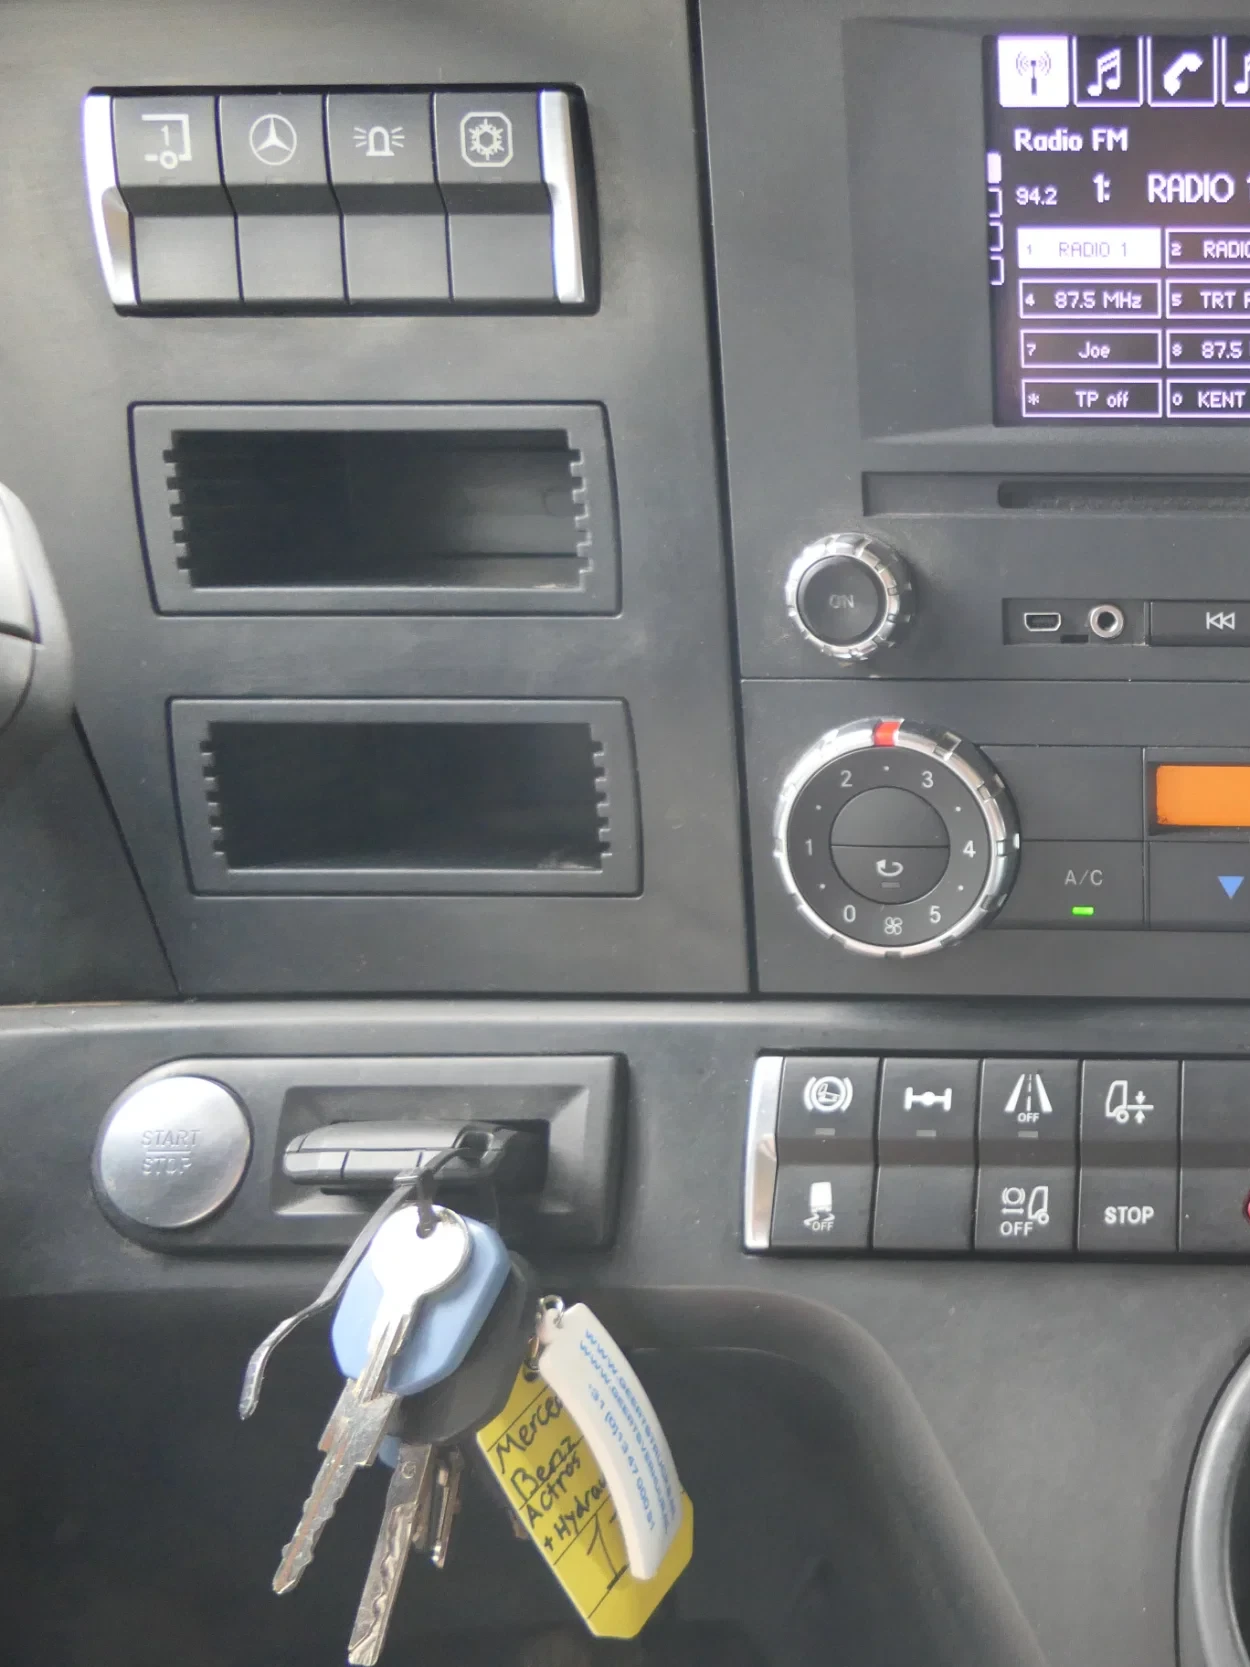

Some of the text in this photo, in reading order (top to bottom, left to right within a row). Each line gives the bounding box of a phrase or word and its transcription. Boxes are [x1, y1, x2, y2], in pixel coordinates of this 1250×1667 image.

[1014, 128, 1128, 152] Radio FM
[1015, 186, 1057, 205] 94.2
[1093, 173, 1111, 203] 1:
[1147, 173, 1235, 203] RADIO
[1058, 241, 1110, 257] RADIO
[1120, 241, 1128, 257] 1
[1171, 242, 1182, 256] 2
[1025, 291, 1142, 309] 4 87.5 MHz
[1171, 294, 1182, 307] 5
[1201, 292, 1236, 309] TRT
[1026, 342, 1110, 359] 7 Joe
[1172, 344, 1182, 357] 8
[1202, 342, 1242, 359] 87.5
[1076, 390, 1098, 408] TP
[1107, 390, 1129, 408] off
[1197, 391, 1246, 409] KENT
[829, 594, 855, 609] ON
[840, 770, 853, 788] 2
[921, 770, 934, 788] 3
[805, 838, 813, 856] 1
[963, 840, 976, 858] 4
[1064, 869, 1104, 887] A/C
[843, 905, 857, 923] 0
[930, 905, 942, 924] 5
[1017, 1112, 1039, 1123] OFF
[141, 1130, 201, 1148] START
[141, 1156, 193, 1175] STOP
[1104, 1206, 1154, 1225] STOP
[812, 1220, 834, 1232] OFF
[1000, 1221, 1033, 1236] OFF
